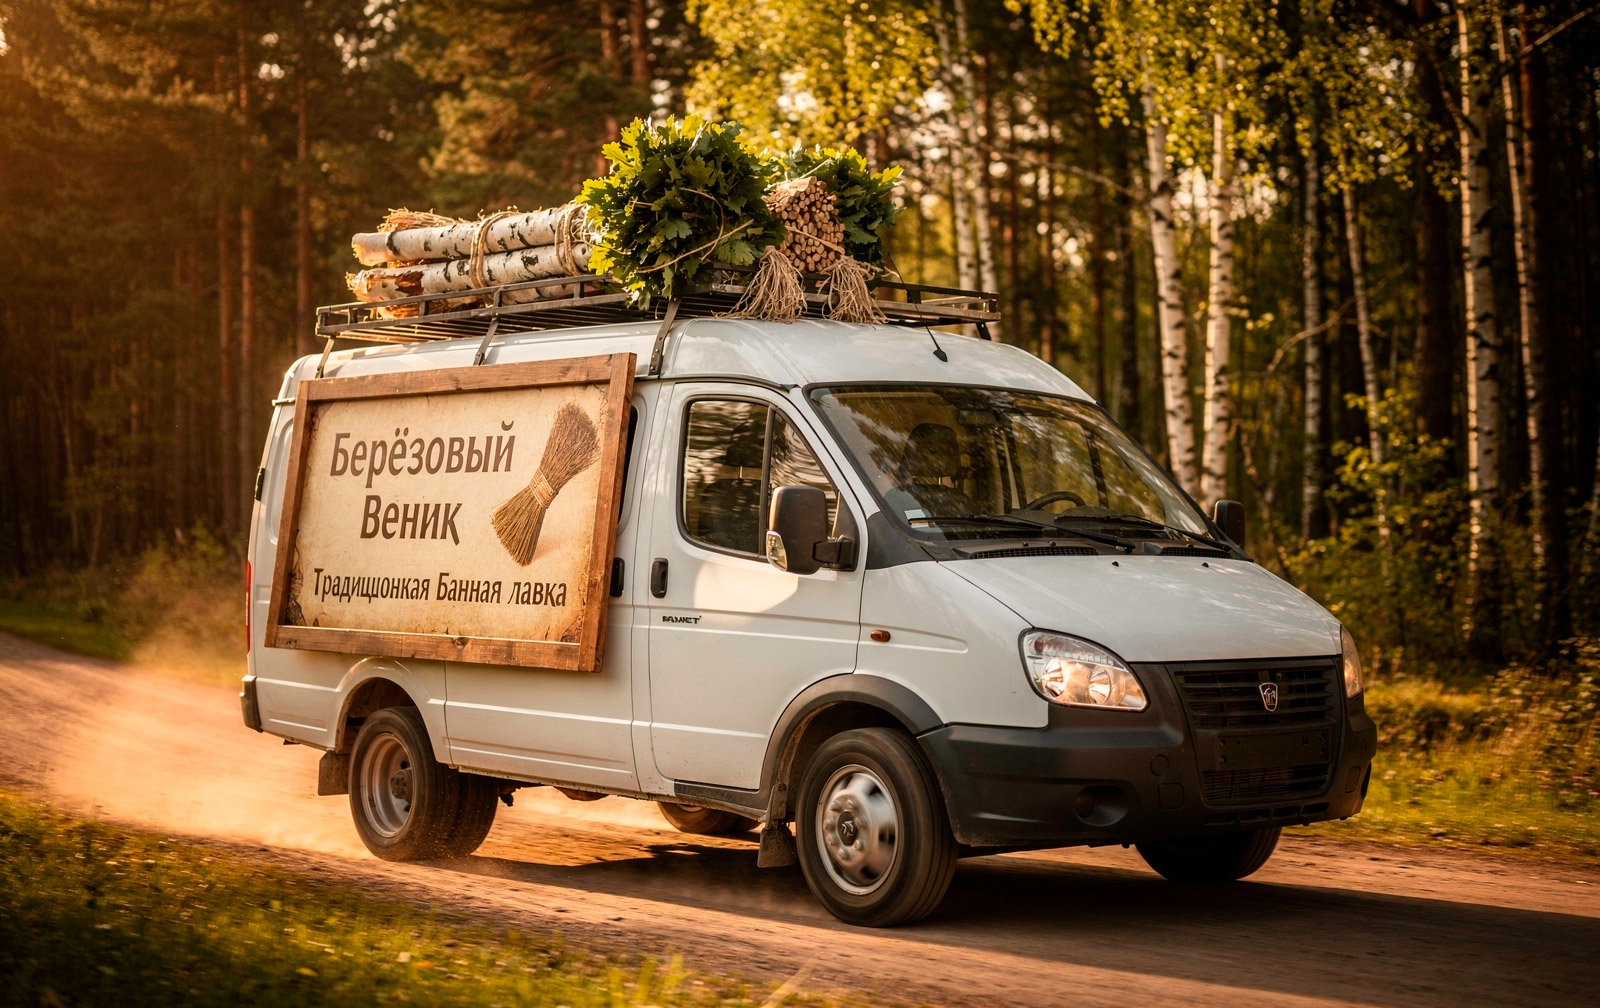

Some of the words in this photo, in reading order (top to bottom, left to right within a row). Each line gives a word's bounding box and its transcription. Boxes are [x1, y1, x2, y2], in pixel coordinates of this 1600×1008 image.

[330, 420, 516, 489] Берёзовый
[360, 494, 463, 546] Веник
[436, 572, 502, 604] Банная
[507, 581, 567, 607] лавка
